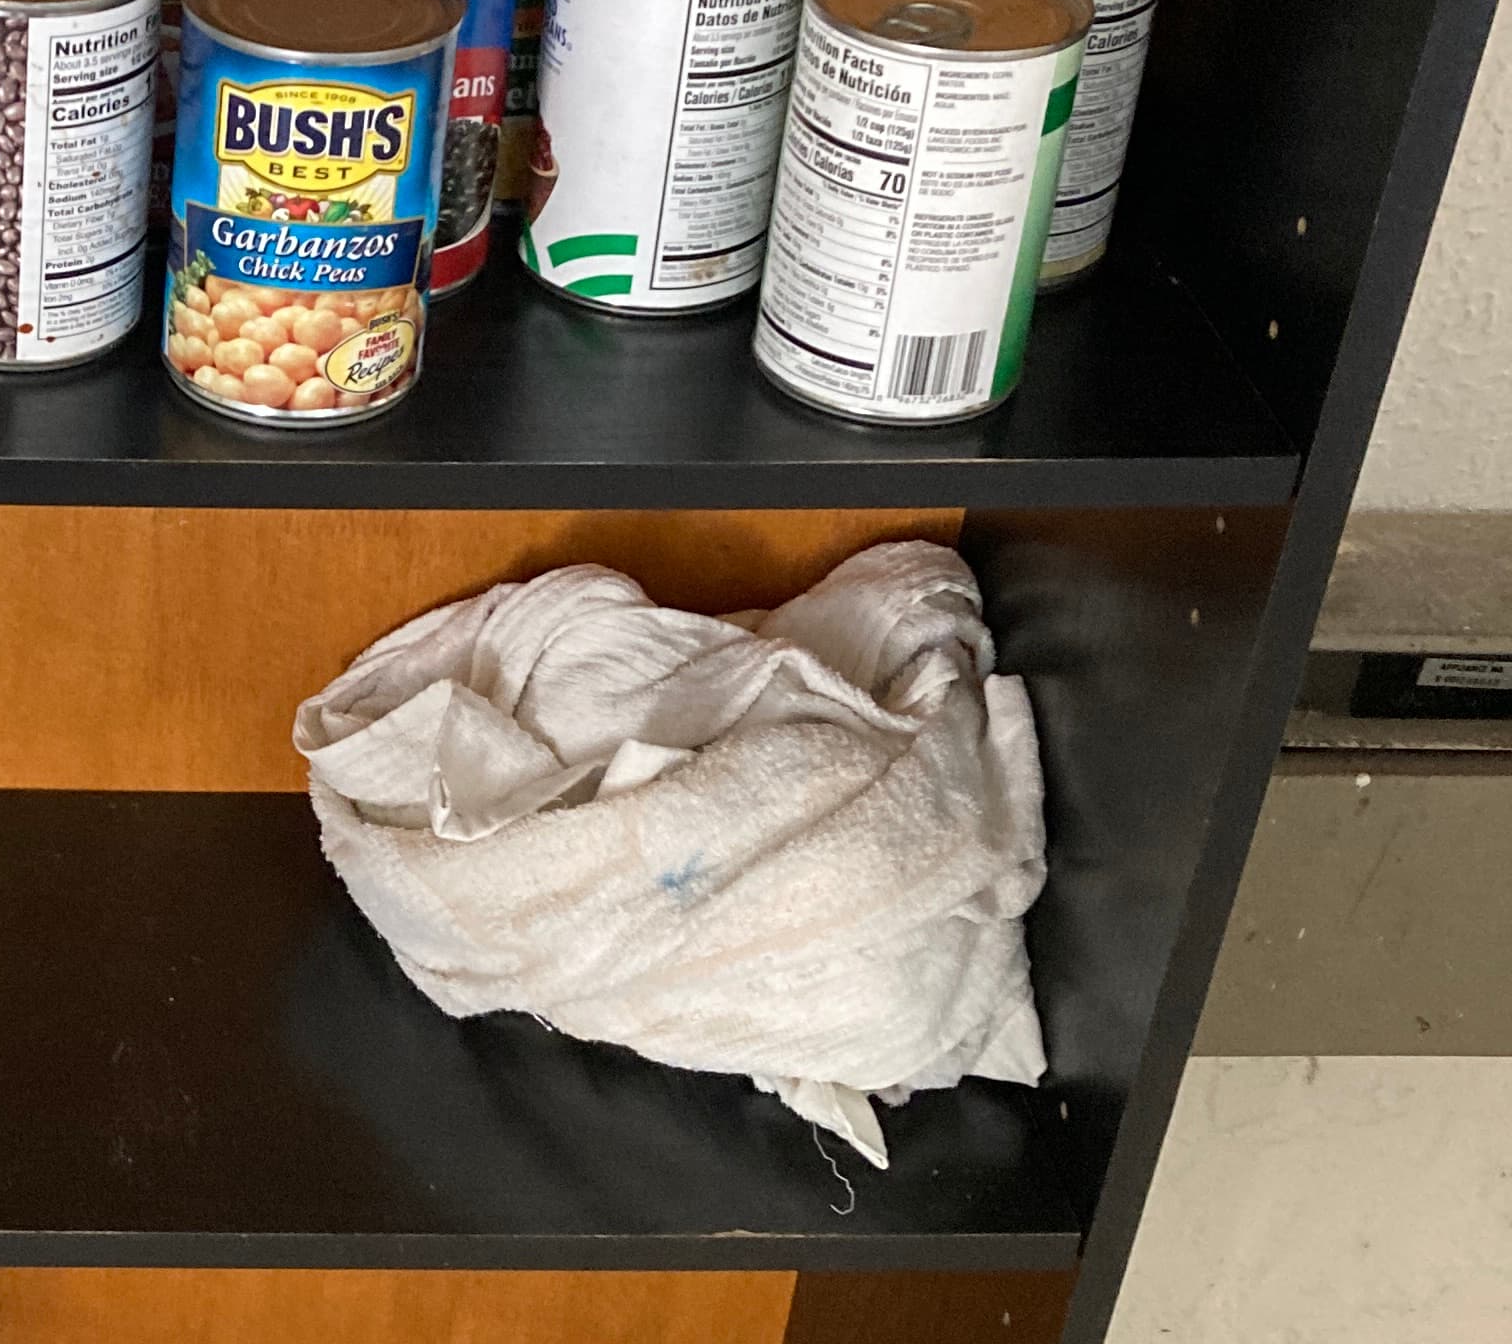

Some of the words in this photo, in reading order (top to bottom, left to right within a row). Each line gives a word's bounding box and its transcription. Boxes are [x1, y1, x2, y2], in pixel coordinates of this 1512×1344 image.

[696, 12, 738, 27] Datos
[742, 9, 759, 24] de
[55, 27, 138, 57] Nutrition
[1087, 28, 1139, 50] Calories
[843, 49, 884, 77] Facts
[53, 72, 96, 85] Serving
[99, 66, 118, 77] size
[822, 60, 836, 79] de
[839, 68, 912, 105] Nutrición
[275, 91, 318, 99] SINCE
[684, 91, 729, 104] Calories
[52, 95, 130, 122] Calories
[224, 93, 405, 161] BUSH'S
[51, 141, 77, 150] Total
[81, 138, 96, 147] Fat
[268, 162, 353, 180] BEST
[48, 176, 106, 191] Cholesterol
[880, 170, 906, 194] 70
[48, 194, 87, 204] Sodium
[48, 207, 74, 217] Total
[211, 216, 398, 260] Garbanzos
[45, 259, 82, 269] Protein
[238, 255, 305, 281] Chick
[313, 264, 367, 283] Peas
[366, 329, 397, 345] FAMILY
[358, 337, 400, 360] FAVORITE
[344, 344, 404, 386] Recipes
